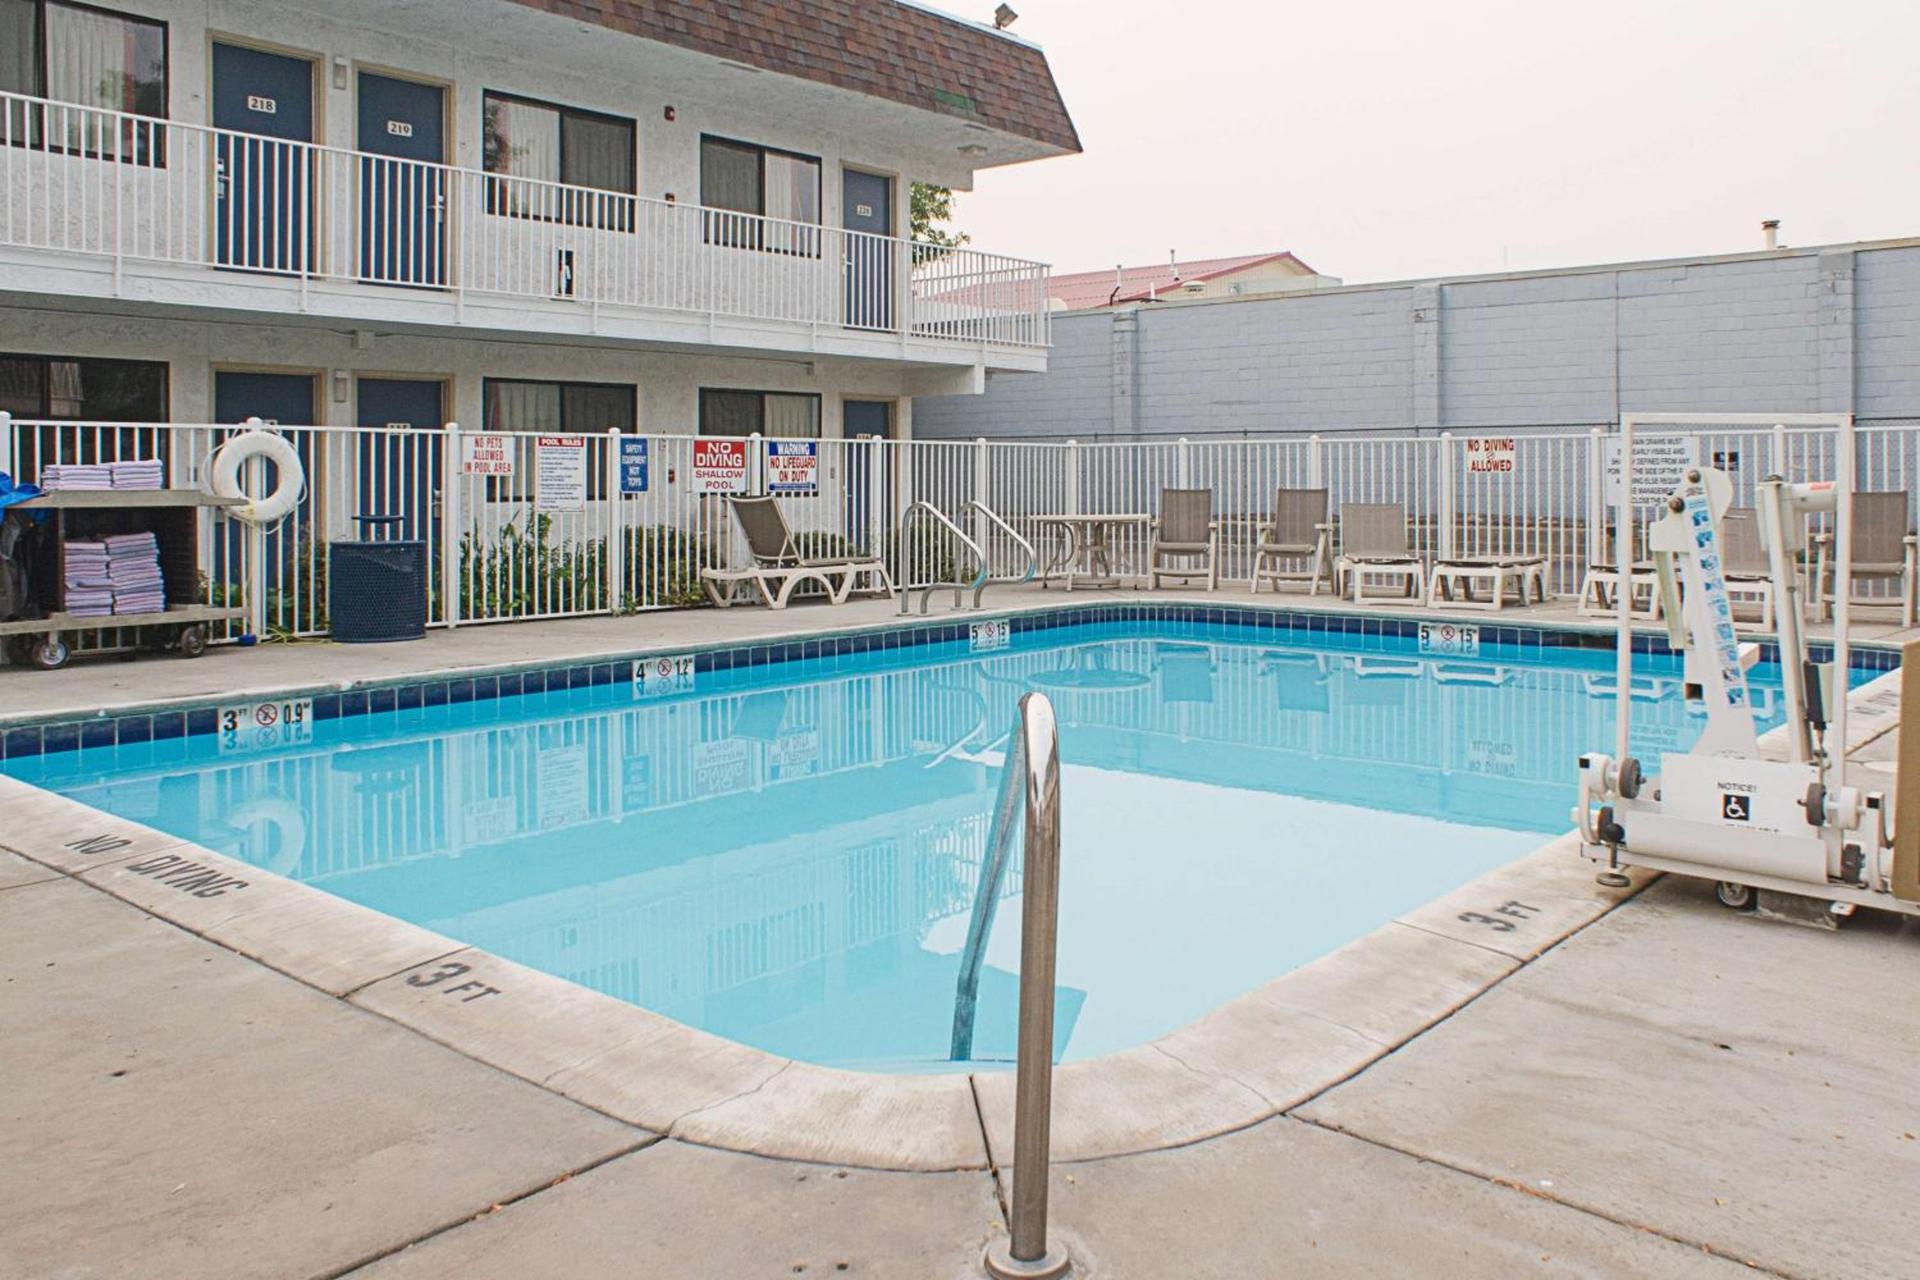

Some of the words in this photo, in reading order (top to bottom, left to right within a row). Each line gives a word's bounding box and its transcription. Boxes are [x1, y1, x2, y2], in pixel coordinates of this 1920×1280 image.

[251, 98, 273, 111] 218
[391, 123, 410, 134] 219
[474, 437, 483, 448] NO
[487, 437, 502, 448] PETS
[541, 438, 560, 446] POOL
[561, 438, 582, 446] RULES
[707, 442, 732, 453] NO
[1467, 439, 1480, 452] NO
[1484, 438, 1514, 452] DIVING
[777, 442, 810, 455] WARNING
[474, 449, 504, 461] ALLOWED
[696, 453, 743, 467] DIVING
[464, 462, 472, 473] IN
[475, 462, 490, 473] POOL
[494, 462, 511, 473] AREA
[770, 457, 780, 469] NO
[783, 457, 817, 469] LIFEGUARD
[1471, 460, 1512, 472] ALLOWED
[695, 470, 744, 479] SHALLOW
[779, 470, 788, 482] ON
[792, 470, 809, 482] DUTY
[705, 481, 735, 489] POOL
[1717, 782, 1757, 793] NOTICE!
[64, 834, 133, 855] NO
[125, 854, 250, 898] DIVING
[1457, 911, 1516, 932] 3
[1495, 900, 1542, 919] FT
[406, 962, 472, 988] 3
[443, 980, 502, 1003] FT
